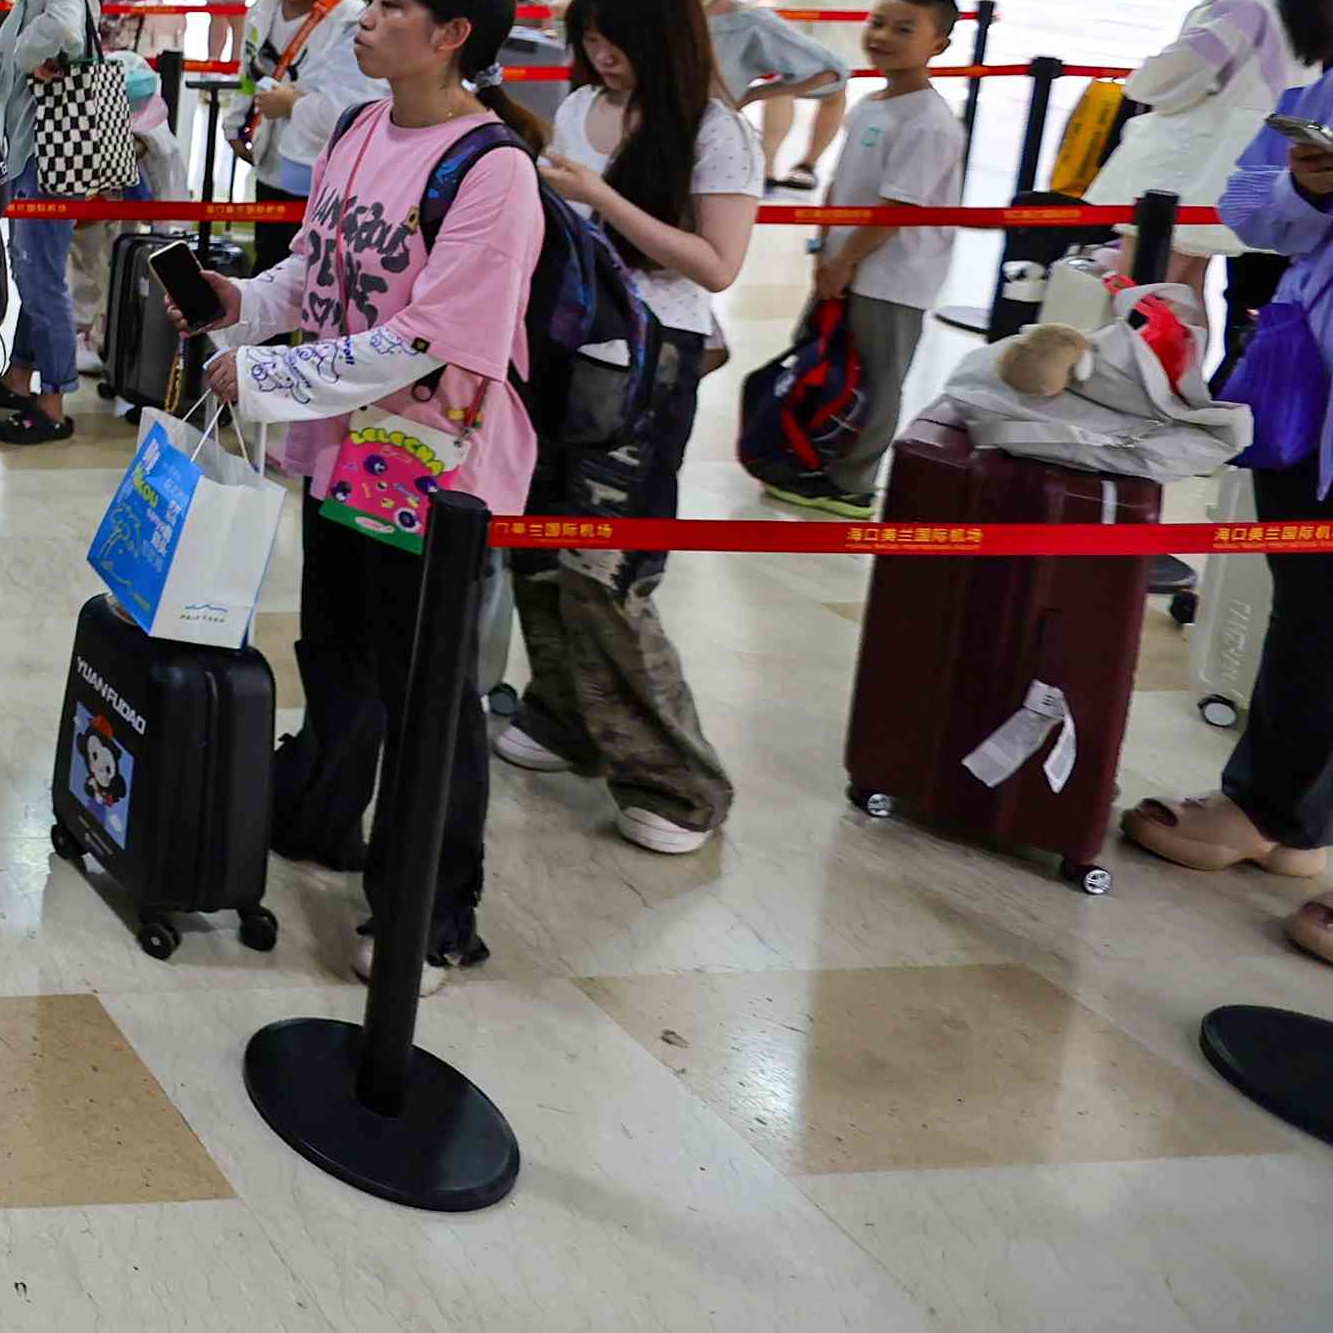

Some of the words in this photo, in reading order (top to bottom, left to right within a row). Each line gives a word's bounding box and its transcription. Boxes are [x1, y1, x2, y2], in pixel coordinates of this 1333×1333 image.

[1213, 525, 1333, 542] 海口美兰国际机
[76, 655, 147, 735] YUANFUDAO
